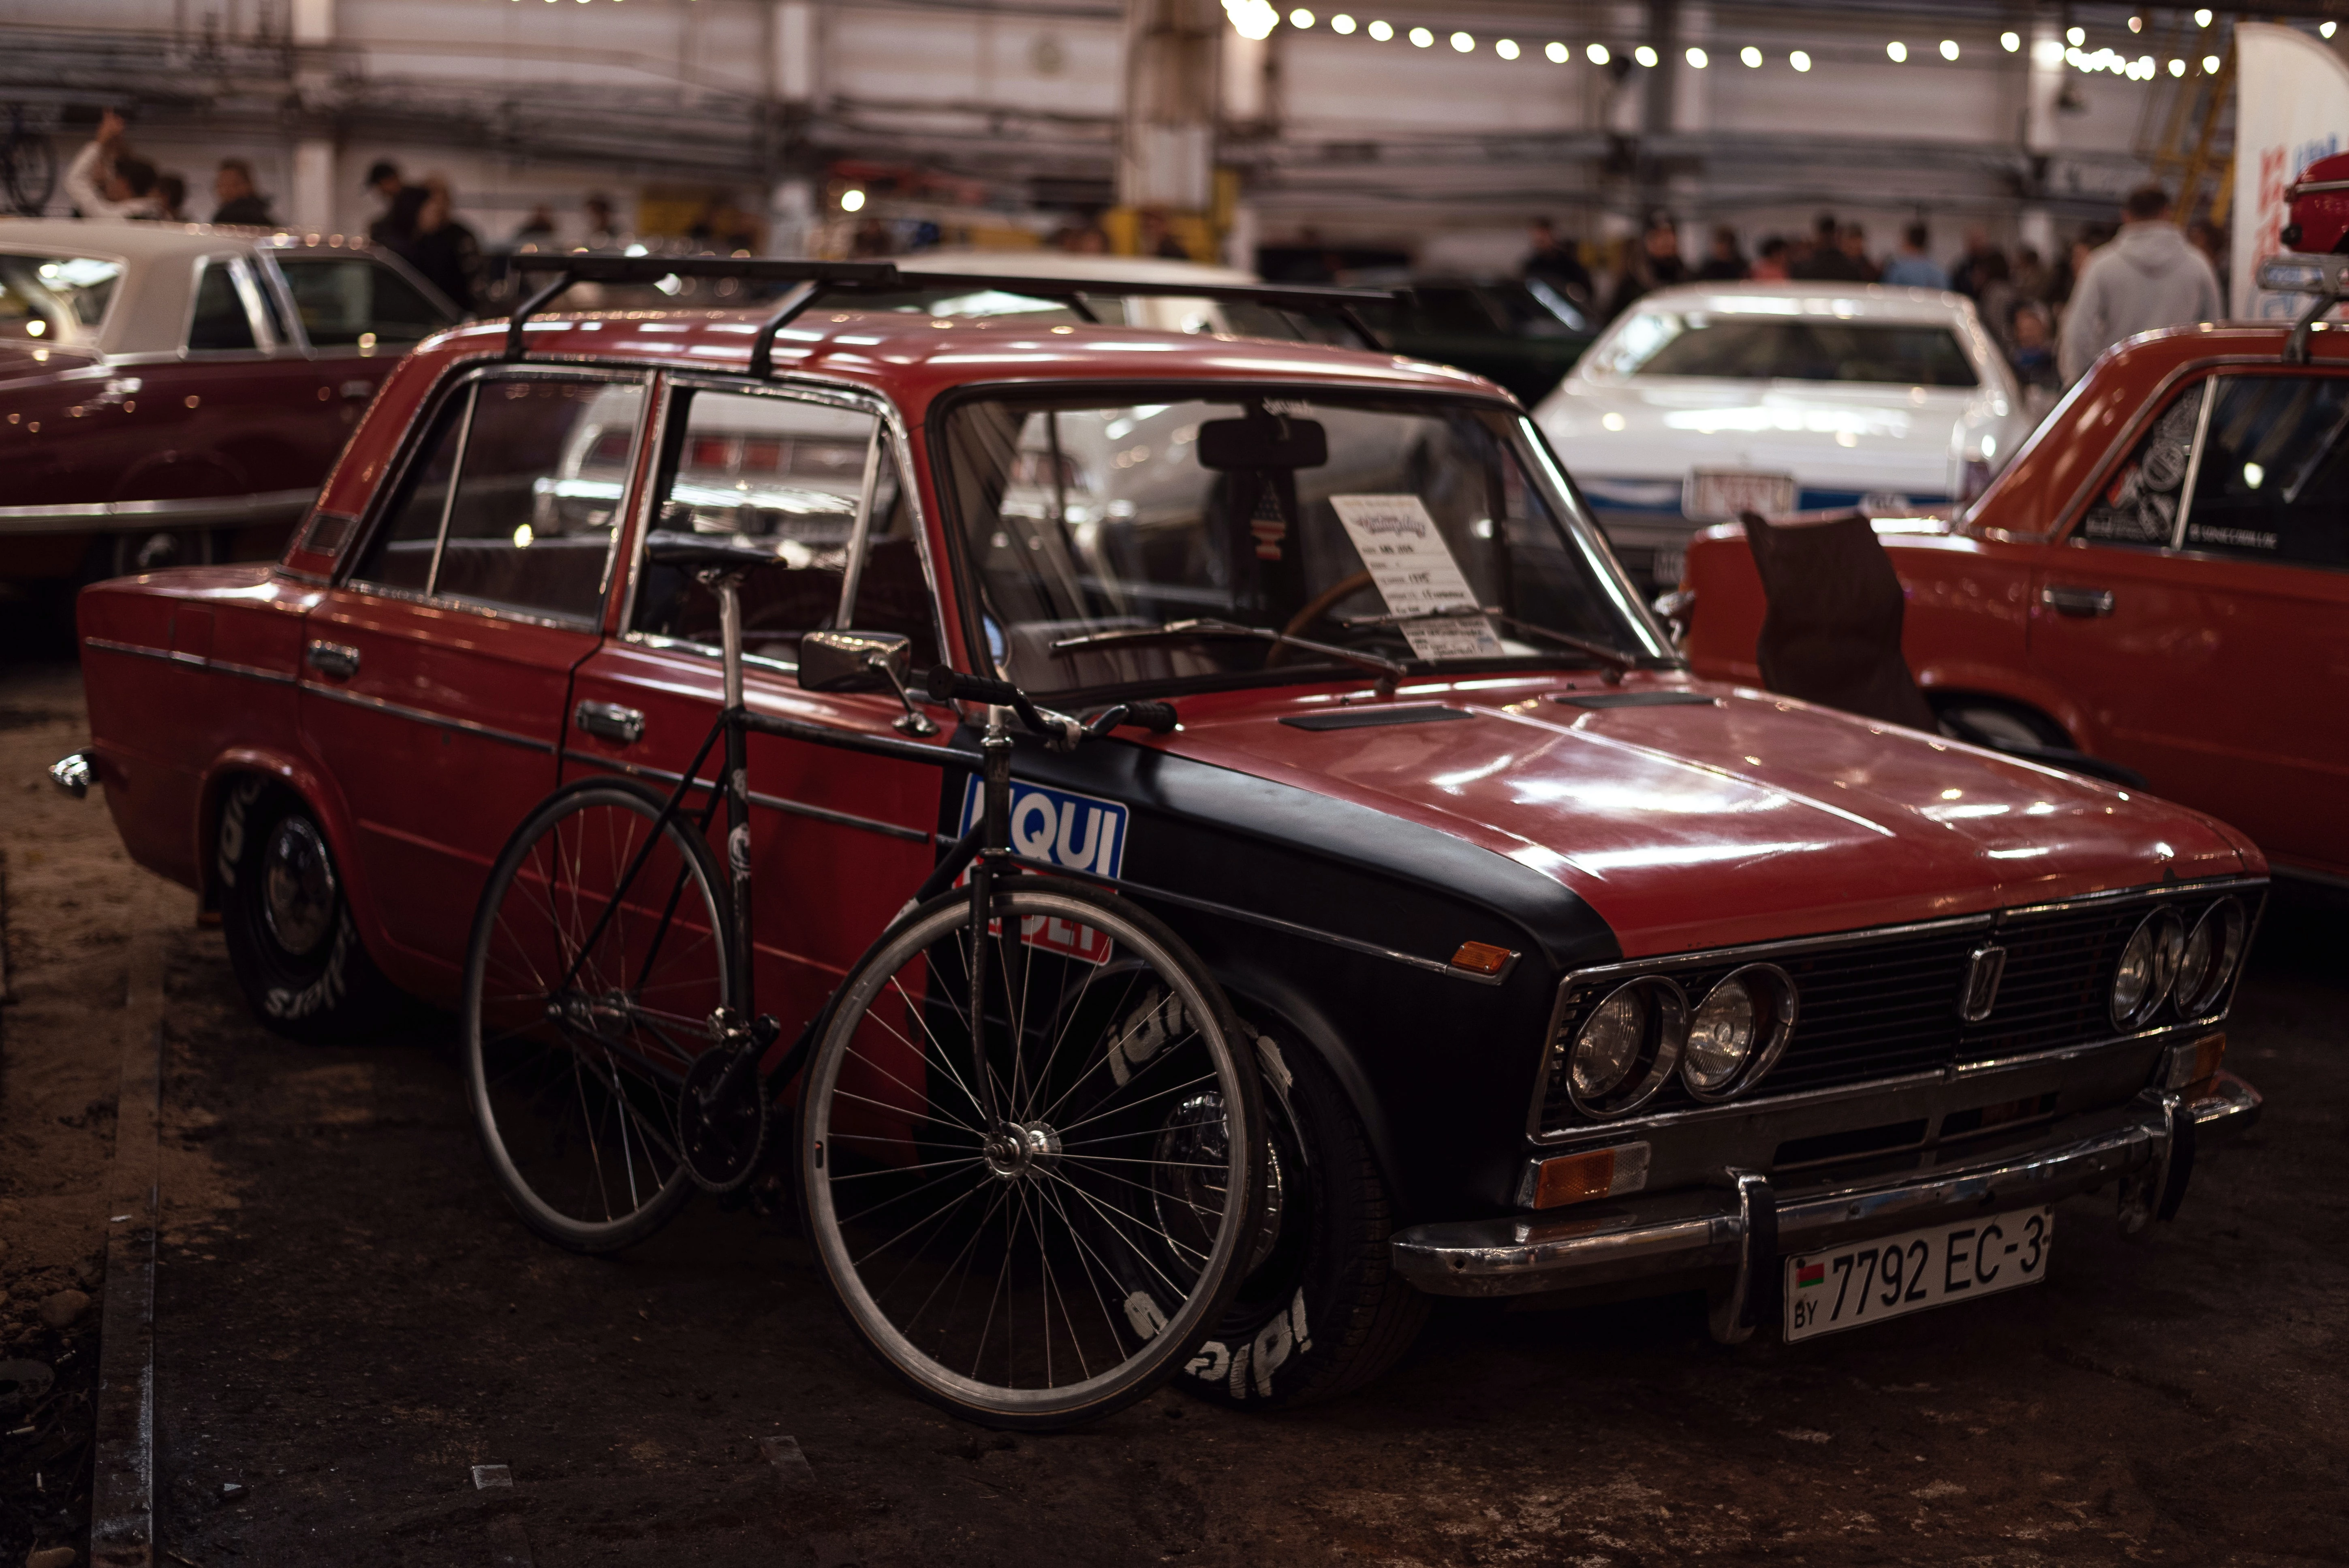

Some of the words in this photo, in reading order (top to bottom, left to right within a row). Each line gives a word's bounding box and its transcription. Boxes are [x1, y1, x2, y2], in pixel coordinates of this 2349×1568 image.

[1830, 1240, 1929, 1321] 7792
[1945, 1216, 2044, 1293] EC-3
[1794, 1299, 1818, 1329] BY
